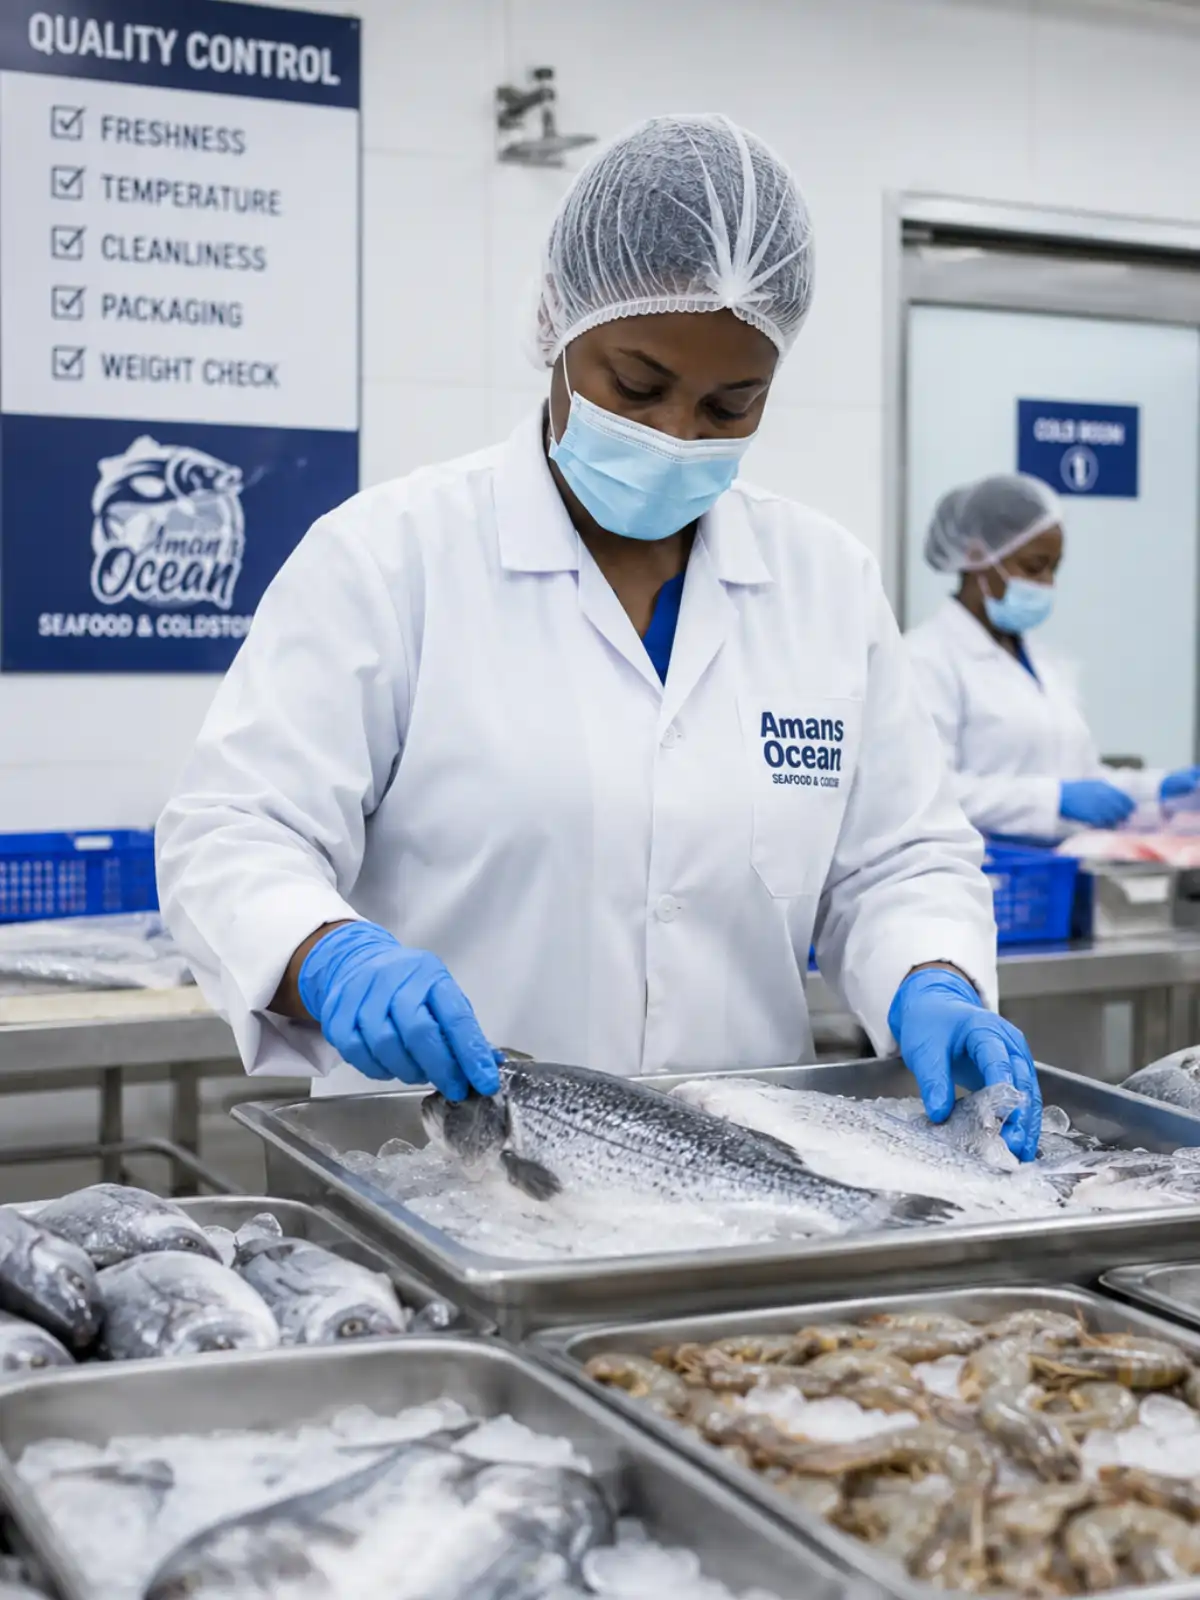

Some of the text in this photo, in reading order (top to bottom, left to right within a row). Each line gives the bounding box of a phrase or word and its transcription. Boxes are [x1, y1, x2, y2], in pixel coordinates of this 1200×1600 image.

[28, 12, 341, 86] QUALITY CONTROL
[101, 115, 246, 155] FRESHNESS
[101, 174, 281, 216] TEMPERATURE
[101, 234, 267, 271] CLEANLINESS
[101, 294, 243, 328] PACKAGING
[101, 354, 280, 388] WEIGHT CHECK
[97, 547, 235, 602] Ocean
[38, 613, 133, 637] SEAFOOD
[136, 614, 153, 637] &
[760, 711, 844, 742] Amans
[763, 740, 842, 772] Ocean
[772, 773, 812, 786] SEAFOOD
[813, 776, 819, 786] &
